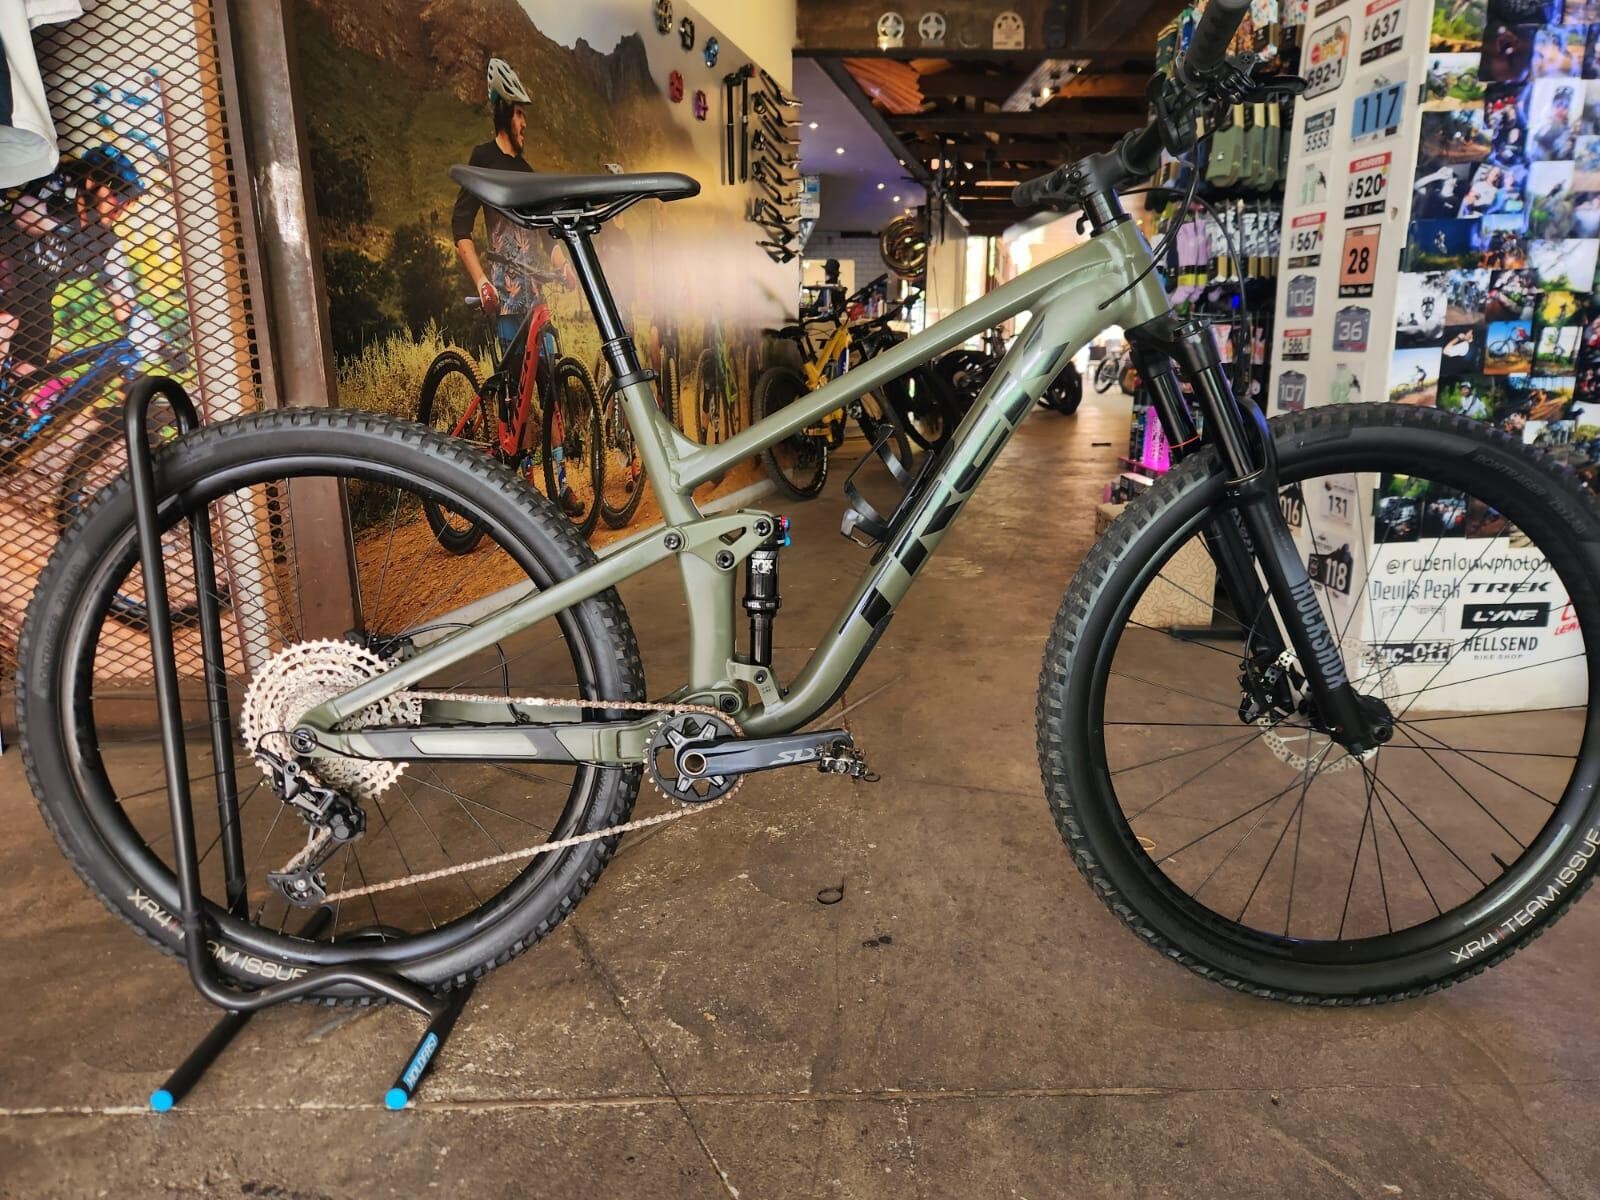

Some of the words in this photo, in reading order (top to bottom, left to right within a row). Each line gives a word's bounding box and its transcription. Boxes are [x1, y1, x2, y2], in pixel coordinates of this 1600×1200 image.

[1371, 9, 1400, 41] 637
[1361, 86, 1400, 133] 117
[1305, 129, 1330, 152] 5553
[1355, 173, 1382, 199] 520
[1296, 230, 1319, 252] 567
[1347, 246, 1370, 275] 28
[1289, 288, 1313, 308] 106
[1338, 321, 1363, 341] 36
[1280, 384, 1305, 402] 107
[1329, 495, 1348, 519] 131
[1325, 557, 1349, 592] 118
[1424, 577, 1460, 600] Peak
[1467, 581, 1552, 594] TREK
[1471, 608, 1540, 623] LYNE
[1462, 636, 1539, 653] HELLSEND
[1450, 932, 1498, 964] XR4
[1500, 884, 1561, 933] TEAM
[1554, 828, 1600, 888] ISSUE
[127, 888, 173, 928] XR4
